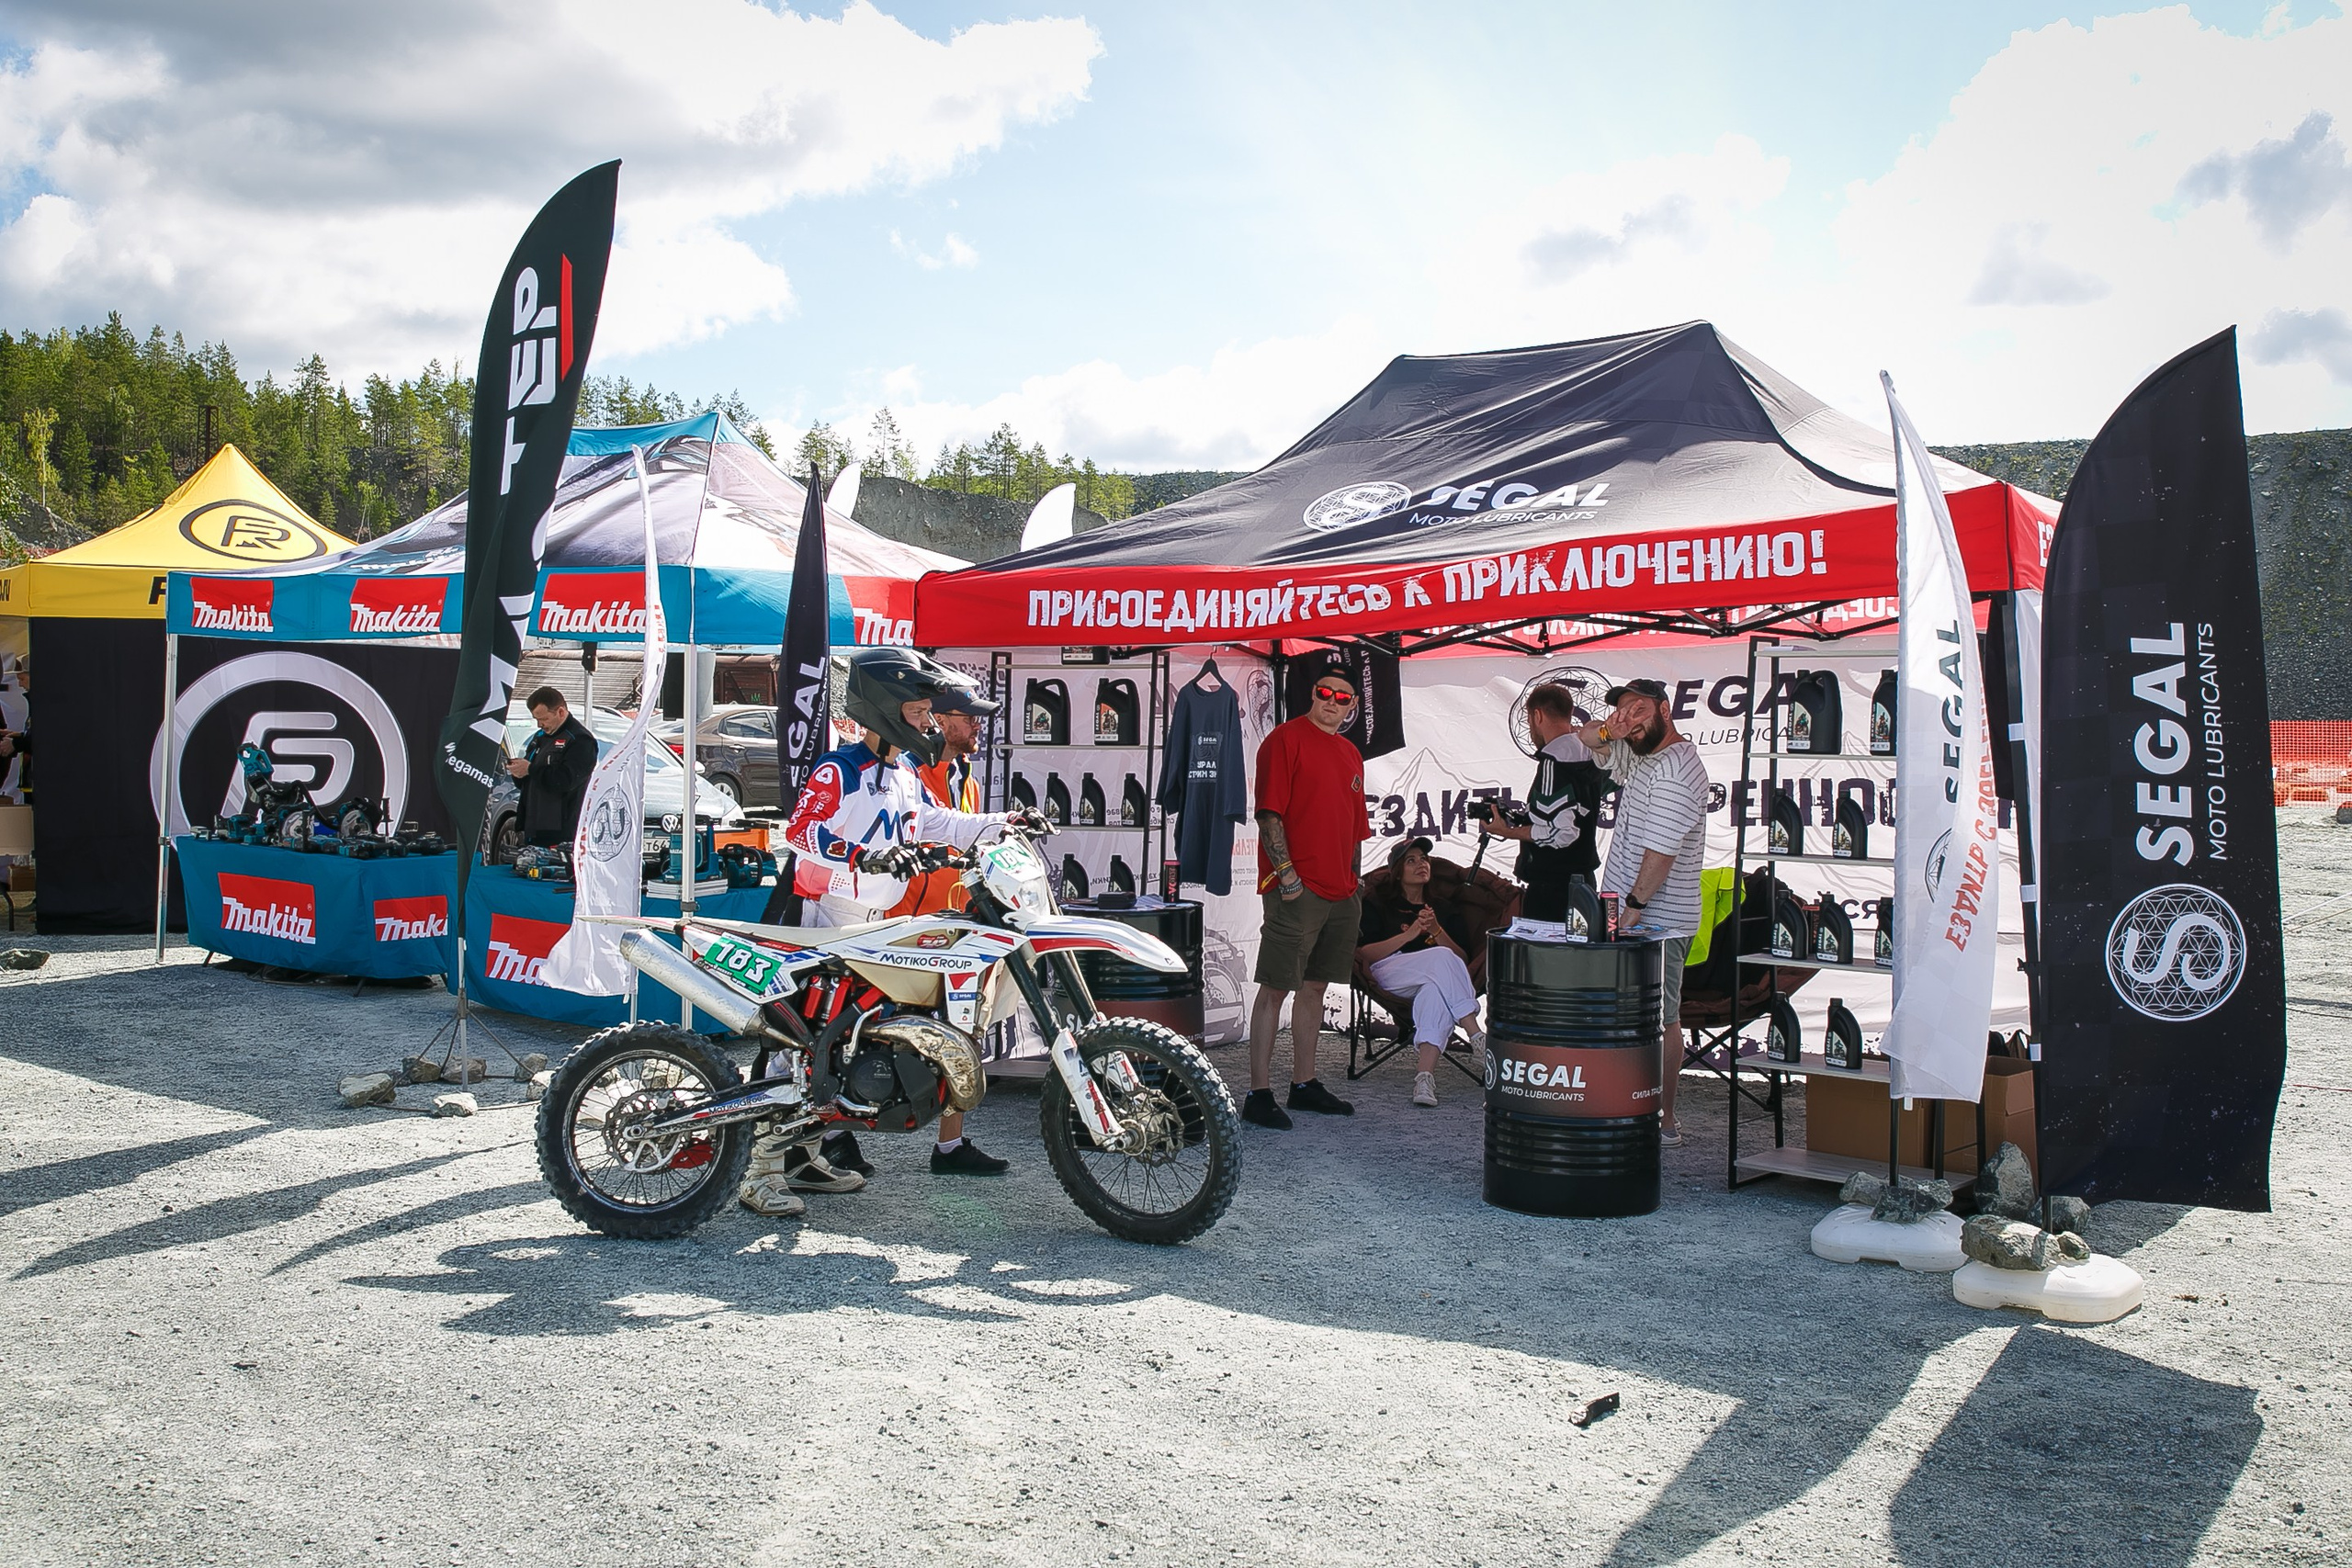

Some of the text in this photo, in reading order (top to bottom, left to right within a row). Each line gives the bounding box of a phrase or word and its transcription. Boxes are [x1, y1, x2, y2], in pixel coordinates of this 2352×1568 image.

[1419, 480, 1611, 511] SEGAL
[1409, 511, 1598, 525] MOTO LUBRICANTS
[1027, 579, 1392, 632] ПРИСОЕДИНЯЙТЕСЬ
[1405, 574, 1432, 608] К
[1443, 528, 1827, 603] ПРИКЛЮЧЕНИЮ!
[192, 601, 274, 633] Makita
[350, 603, 441, 633] Makita
[2130, 623, 2194, 867] SEGAL
[2197, 623, 2227, 861] MOTO LUBRICANTS
[221, 897, 316, 944] Makita
[375, 913, 448, 942] Maki
[1608, 901, 1617, 932] VOLT
[715, 941, 773, 984] 183
[1501, 1058, 1588, 1089] SEGAL
[1501, 1085, 1586, 1102] MOTO LUBRICANTS
